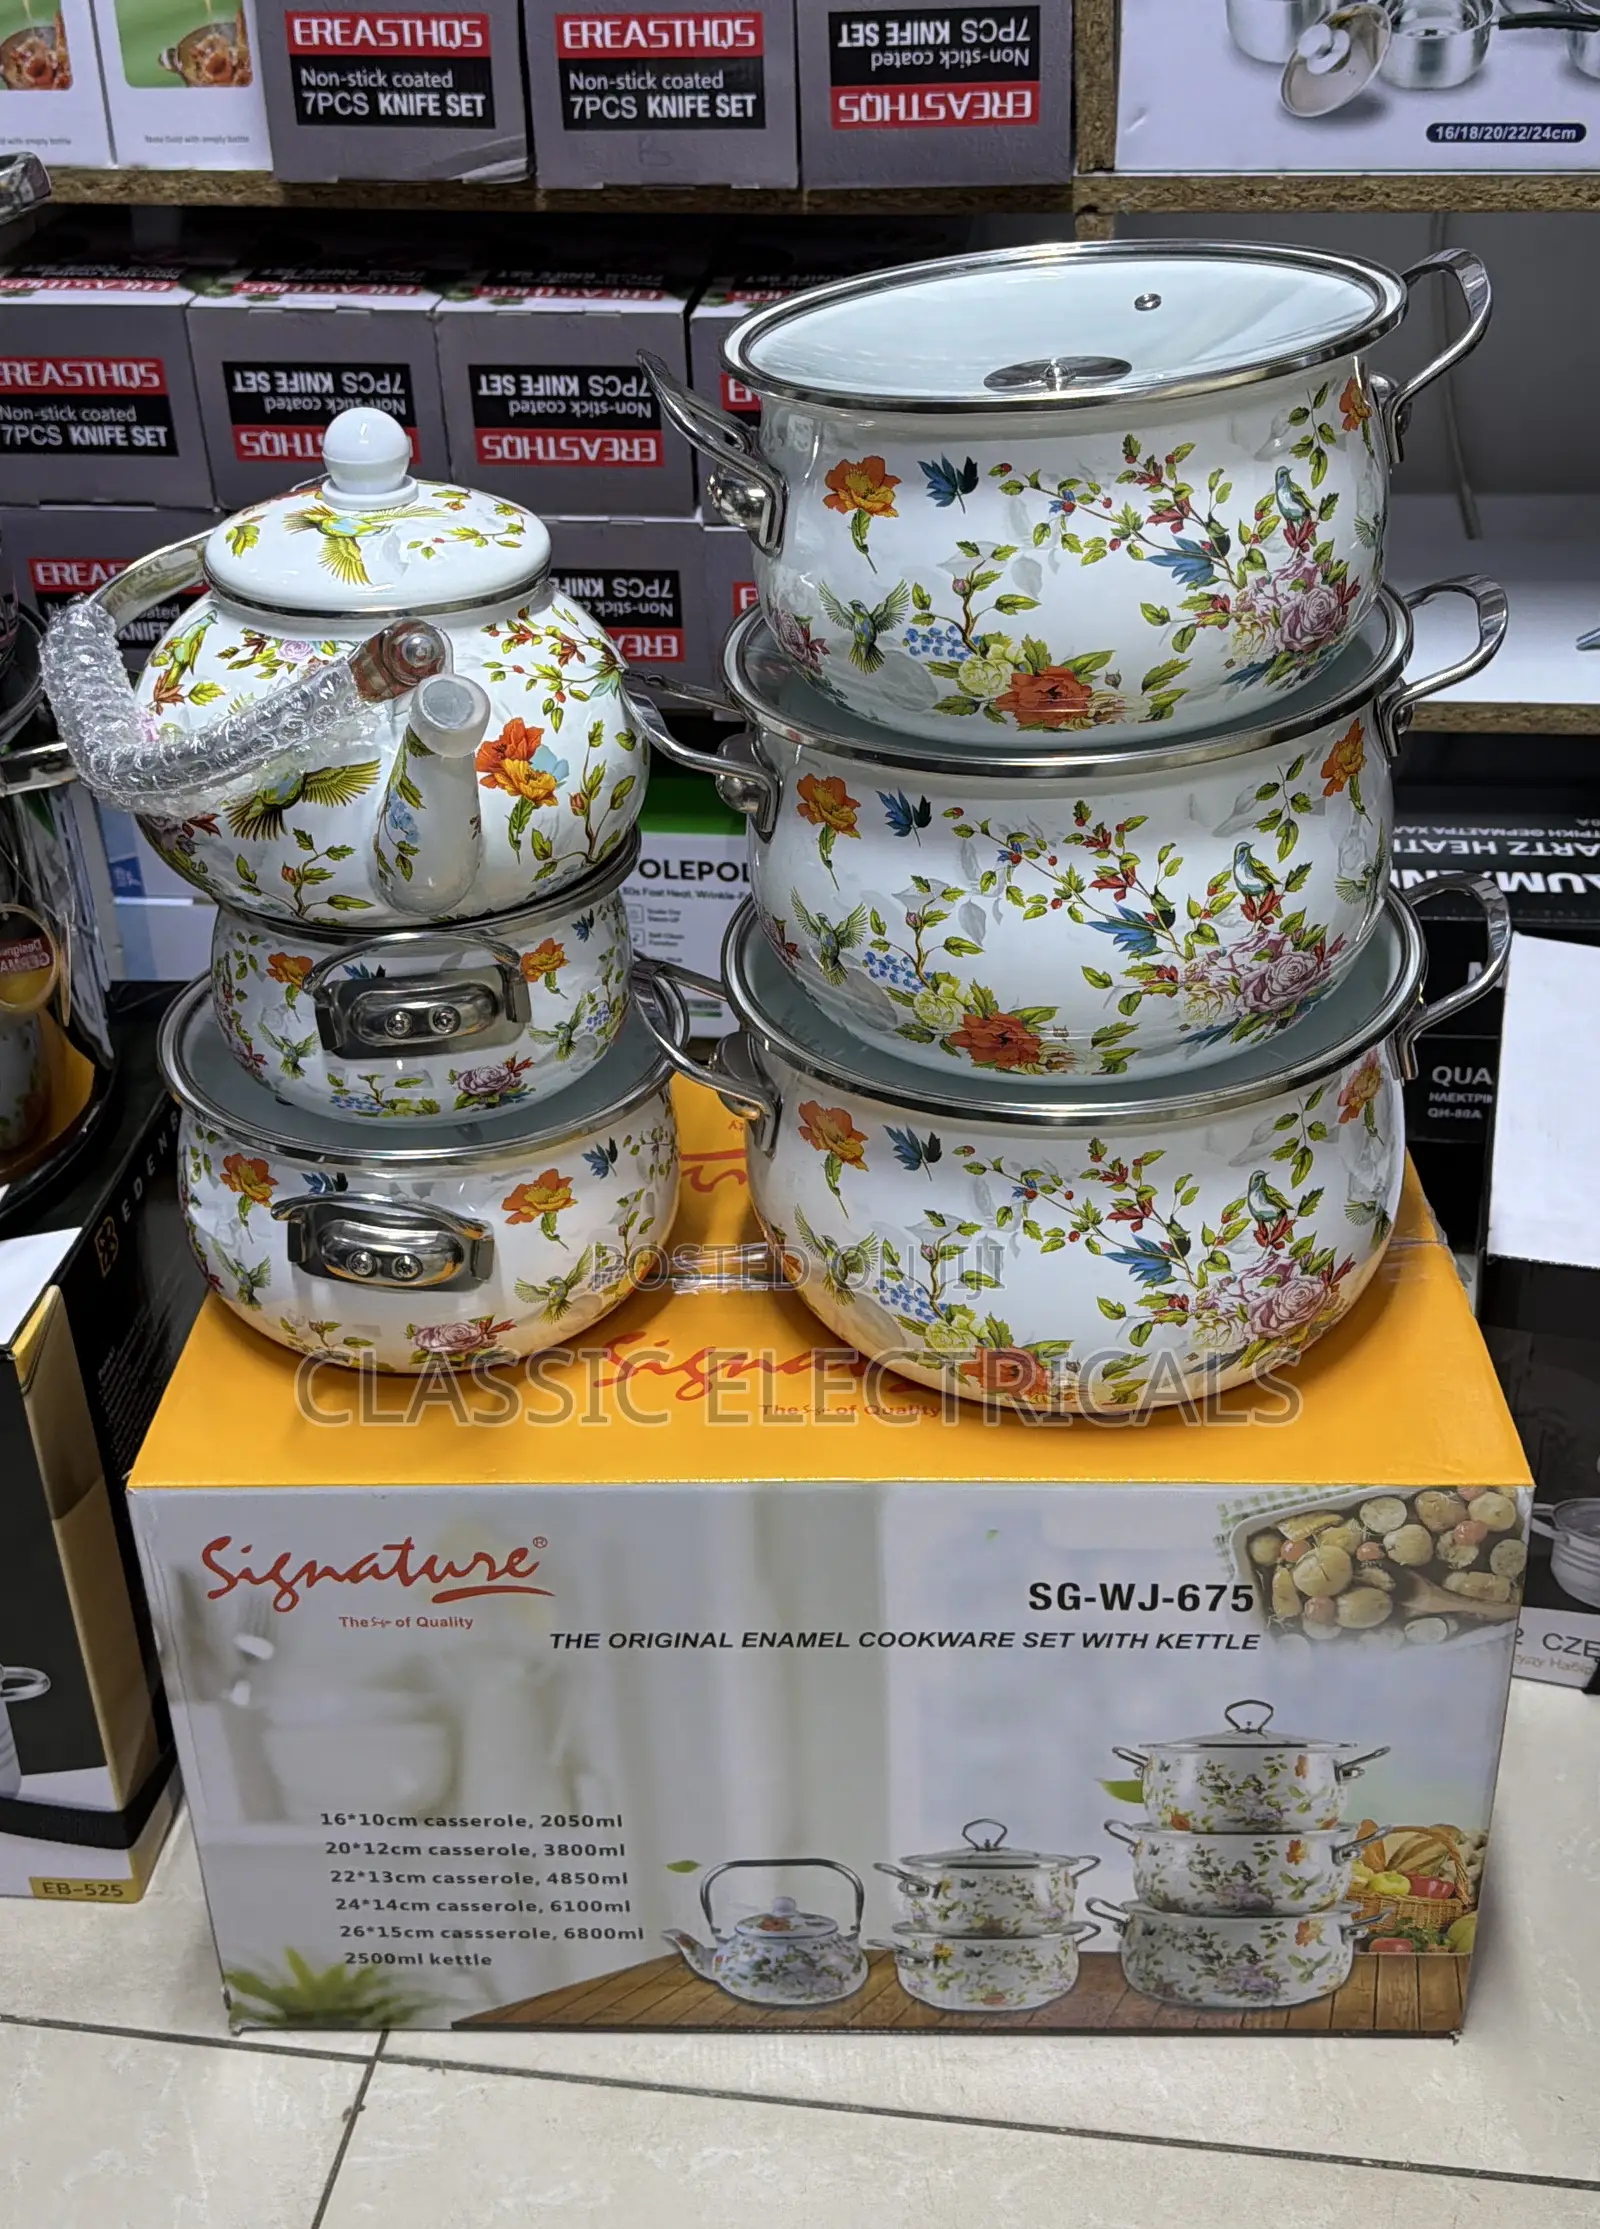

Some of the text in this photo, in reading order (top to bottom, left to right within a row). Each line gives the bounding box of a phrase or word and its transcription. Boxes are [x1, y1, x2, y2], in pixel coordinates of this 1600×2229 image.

[293, 19, 482, 49] EREASTHQS
[563, 19, 756, 49] EREASTHQS
[838, 17, 1031, 47] 7PCS KNIFE SET
[871, 47, 1029, 71] Non-stick coated
[301, 67, 453, 88] Non-stick coated
[569, 70, 724, 90] Non-stick coated
[302, 92, 486, 117] 7PCS KNIFE SET
[570, 94, 757, 119] 7PCS KNIFE SET
[838, 90, 1032, 123] EREASTHQS
[1435, 125, 1577, 141] 16/18/20/22/24cm
[233, 370, 405, 394] 7PCS KNIFE SET
[478, 374, 652, 397] 7PCS KNIFE SET
[81, 405, 137, 422] coated
[263, 396, 322, 414] coated
[508, 400, 652, 418] Non-stick coated
[2, 424, 168, 447] 7PCS KNIFE SET
[482, 434, 657, 462] EREASTHQS
[612, 577, 674, 599] 7PCS
[595, 600, 674, 618] Non-stick
[1029, 1582, 1254, 1613] SG-WJ-675
[338, 1616, 370, 1629] The
[395, 1616, 413, 1629] of
[416, 1616, 475, 1631] Quality
[550, 1632, 1261, 1650] THE ORIGINAL ENAMEL COOKWARE SET WITH KETTLE
[424, 1815, 535, 1829] casserole,
[540, 1815, 623, 1828] 2050ml
[428, 1844, 538, 1858] casserole,
[544, 1844, 626, 1857] 3800ml
[432, 1872, 540, 1886] casserole,
[546, 1872, 629, 1885] 4850ml
[43, 1882, 124, 1898] EB-525
[436, 1900, 544, 1914] casserole,
[550, 1900, 631, 1913] 6100ml
[440, 1927, 557, 1942] cassserole,
[564, 1927, 645, 1941] 6800ml
[345, 1952, 493, 1967] 2500ml kettle
